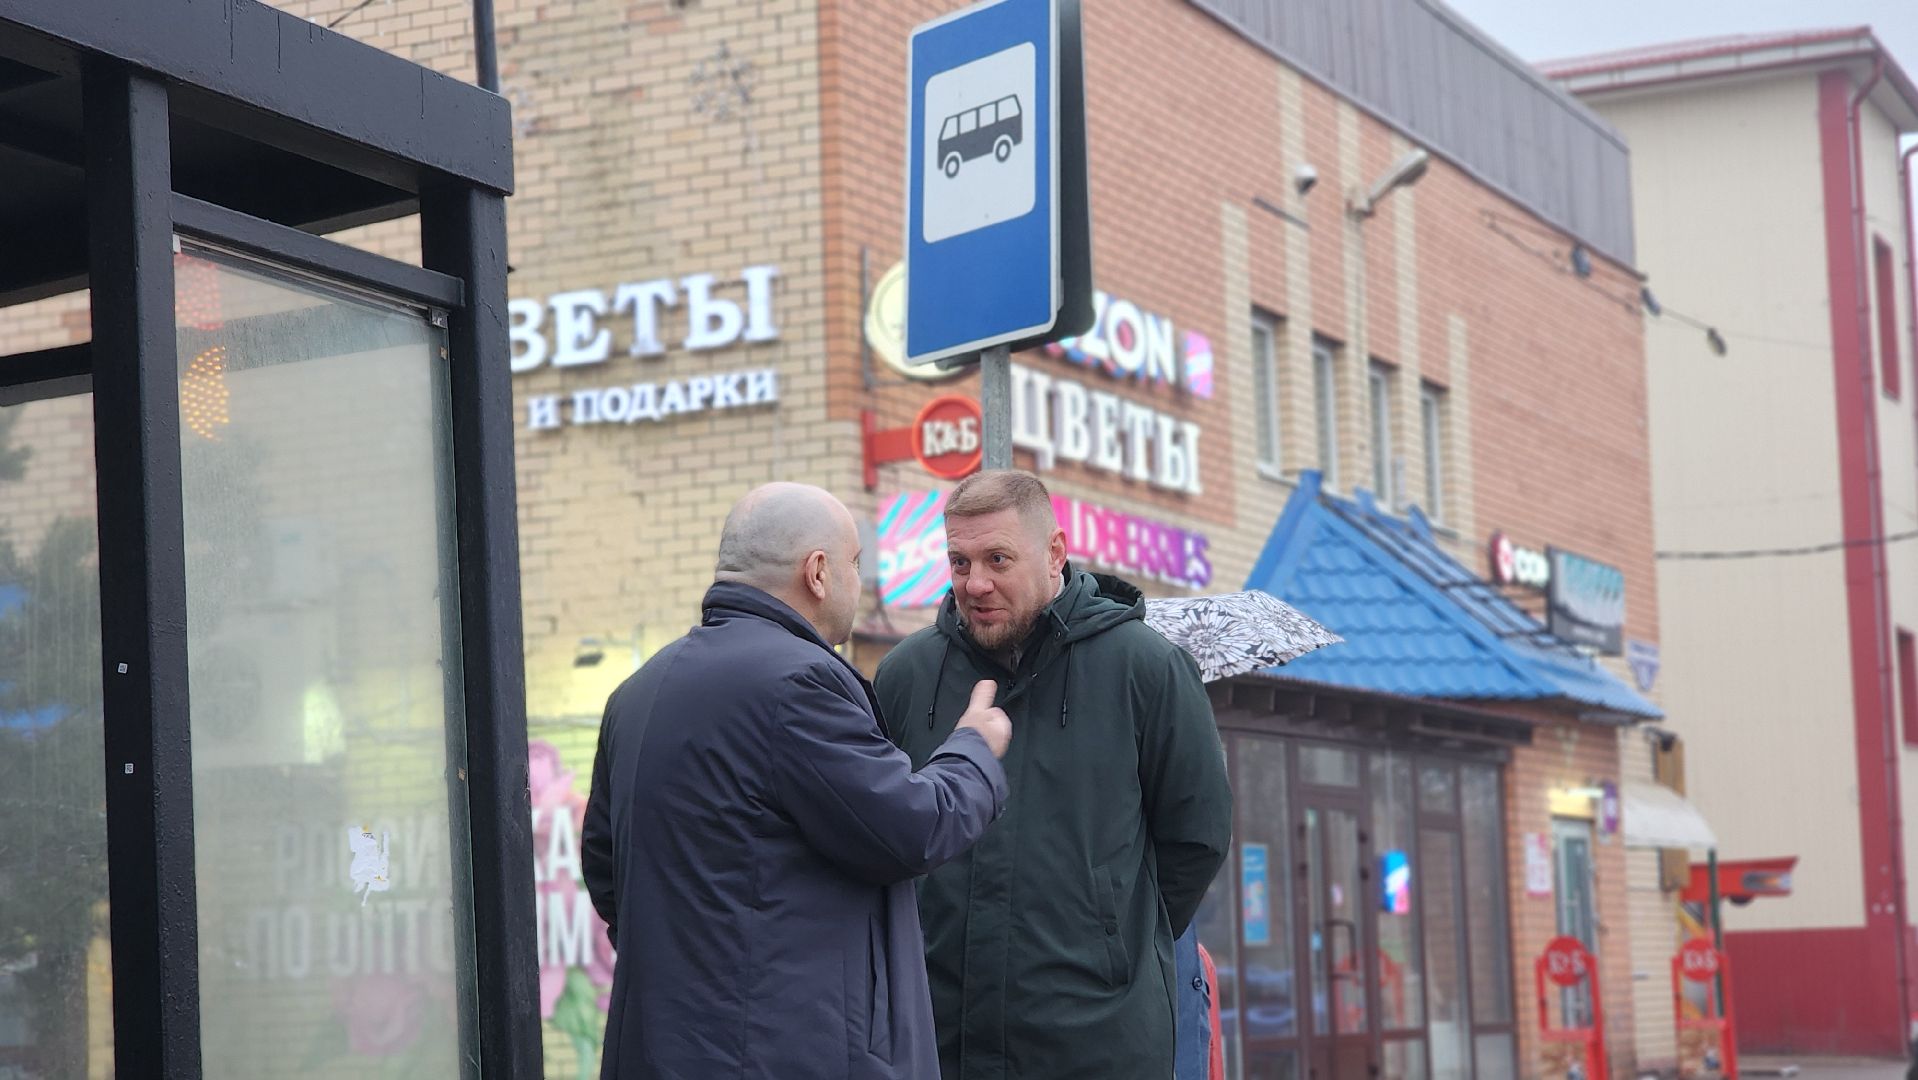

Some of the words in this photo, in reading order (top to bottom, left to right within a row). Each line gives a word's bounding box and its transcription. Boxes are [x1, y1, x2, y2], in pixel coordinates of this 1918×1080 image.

[508, 265, 779, 373] ВЕТЫ
[1060, 290, 1176, 384] ZON
[527, 395, 560, 428] И
[572, 369, 777, 424] ПОДАРКИ
[1010, 362, 1201, 495] ЦВЕТЫ
[1052, 491, 1213, 589] LDBERRIES
